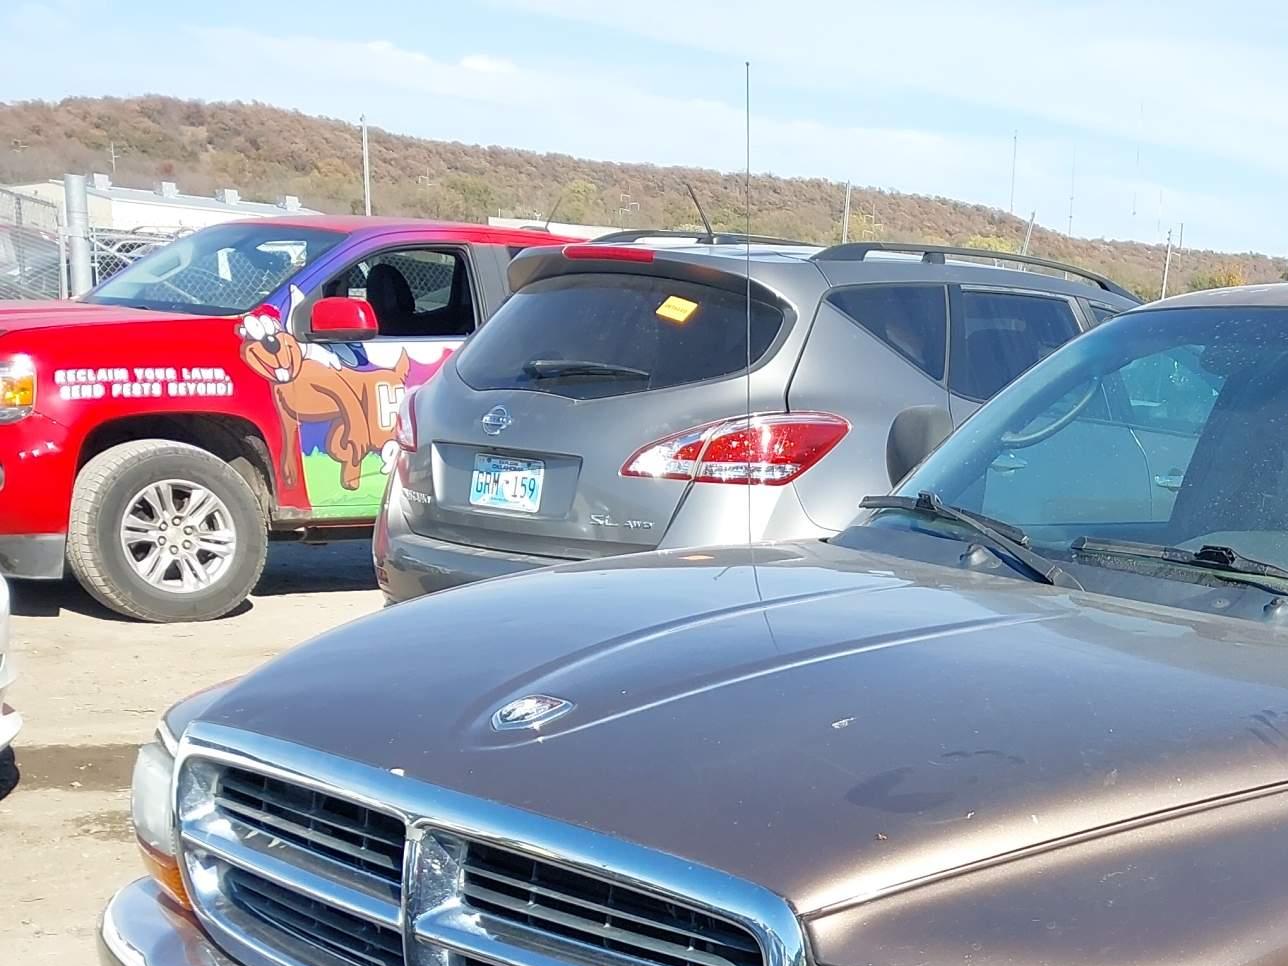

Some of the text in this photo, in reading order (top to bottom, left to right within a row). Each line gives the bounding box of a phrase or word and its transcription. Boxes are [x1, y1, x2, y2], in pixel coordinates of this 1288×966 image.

[54, 367, 231, 385] RECLAIM YOUR LAWN,
[111, 382, 162, 398] PESTS
[167, 382, 233, 397] BEYOND!
[475, 471, 536, 499] GRM 159
[589, 514, 619, 527] SL
